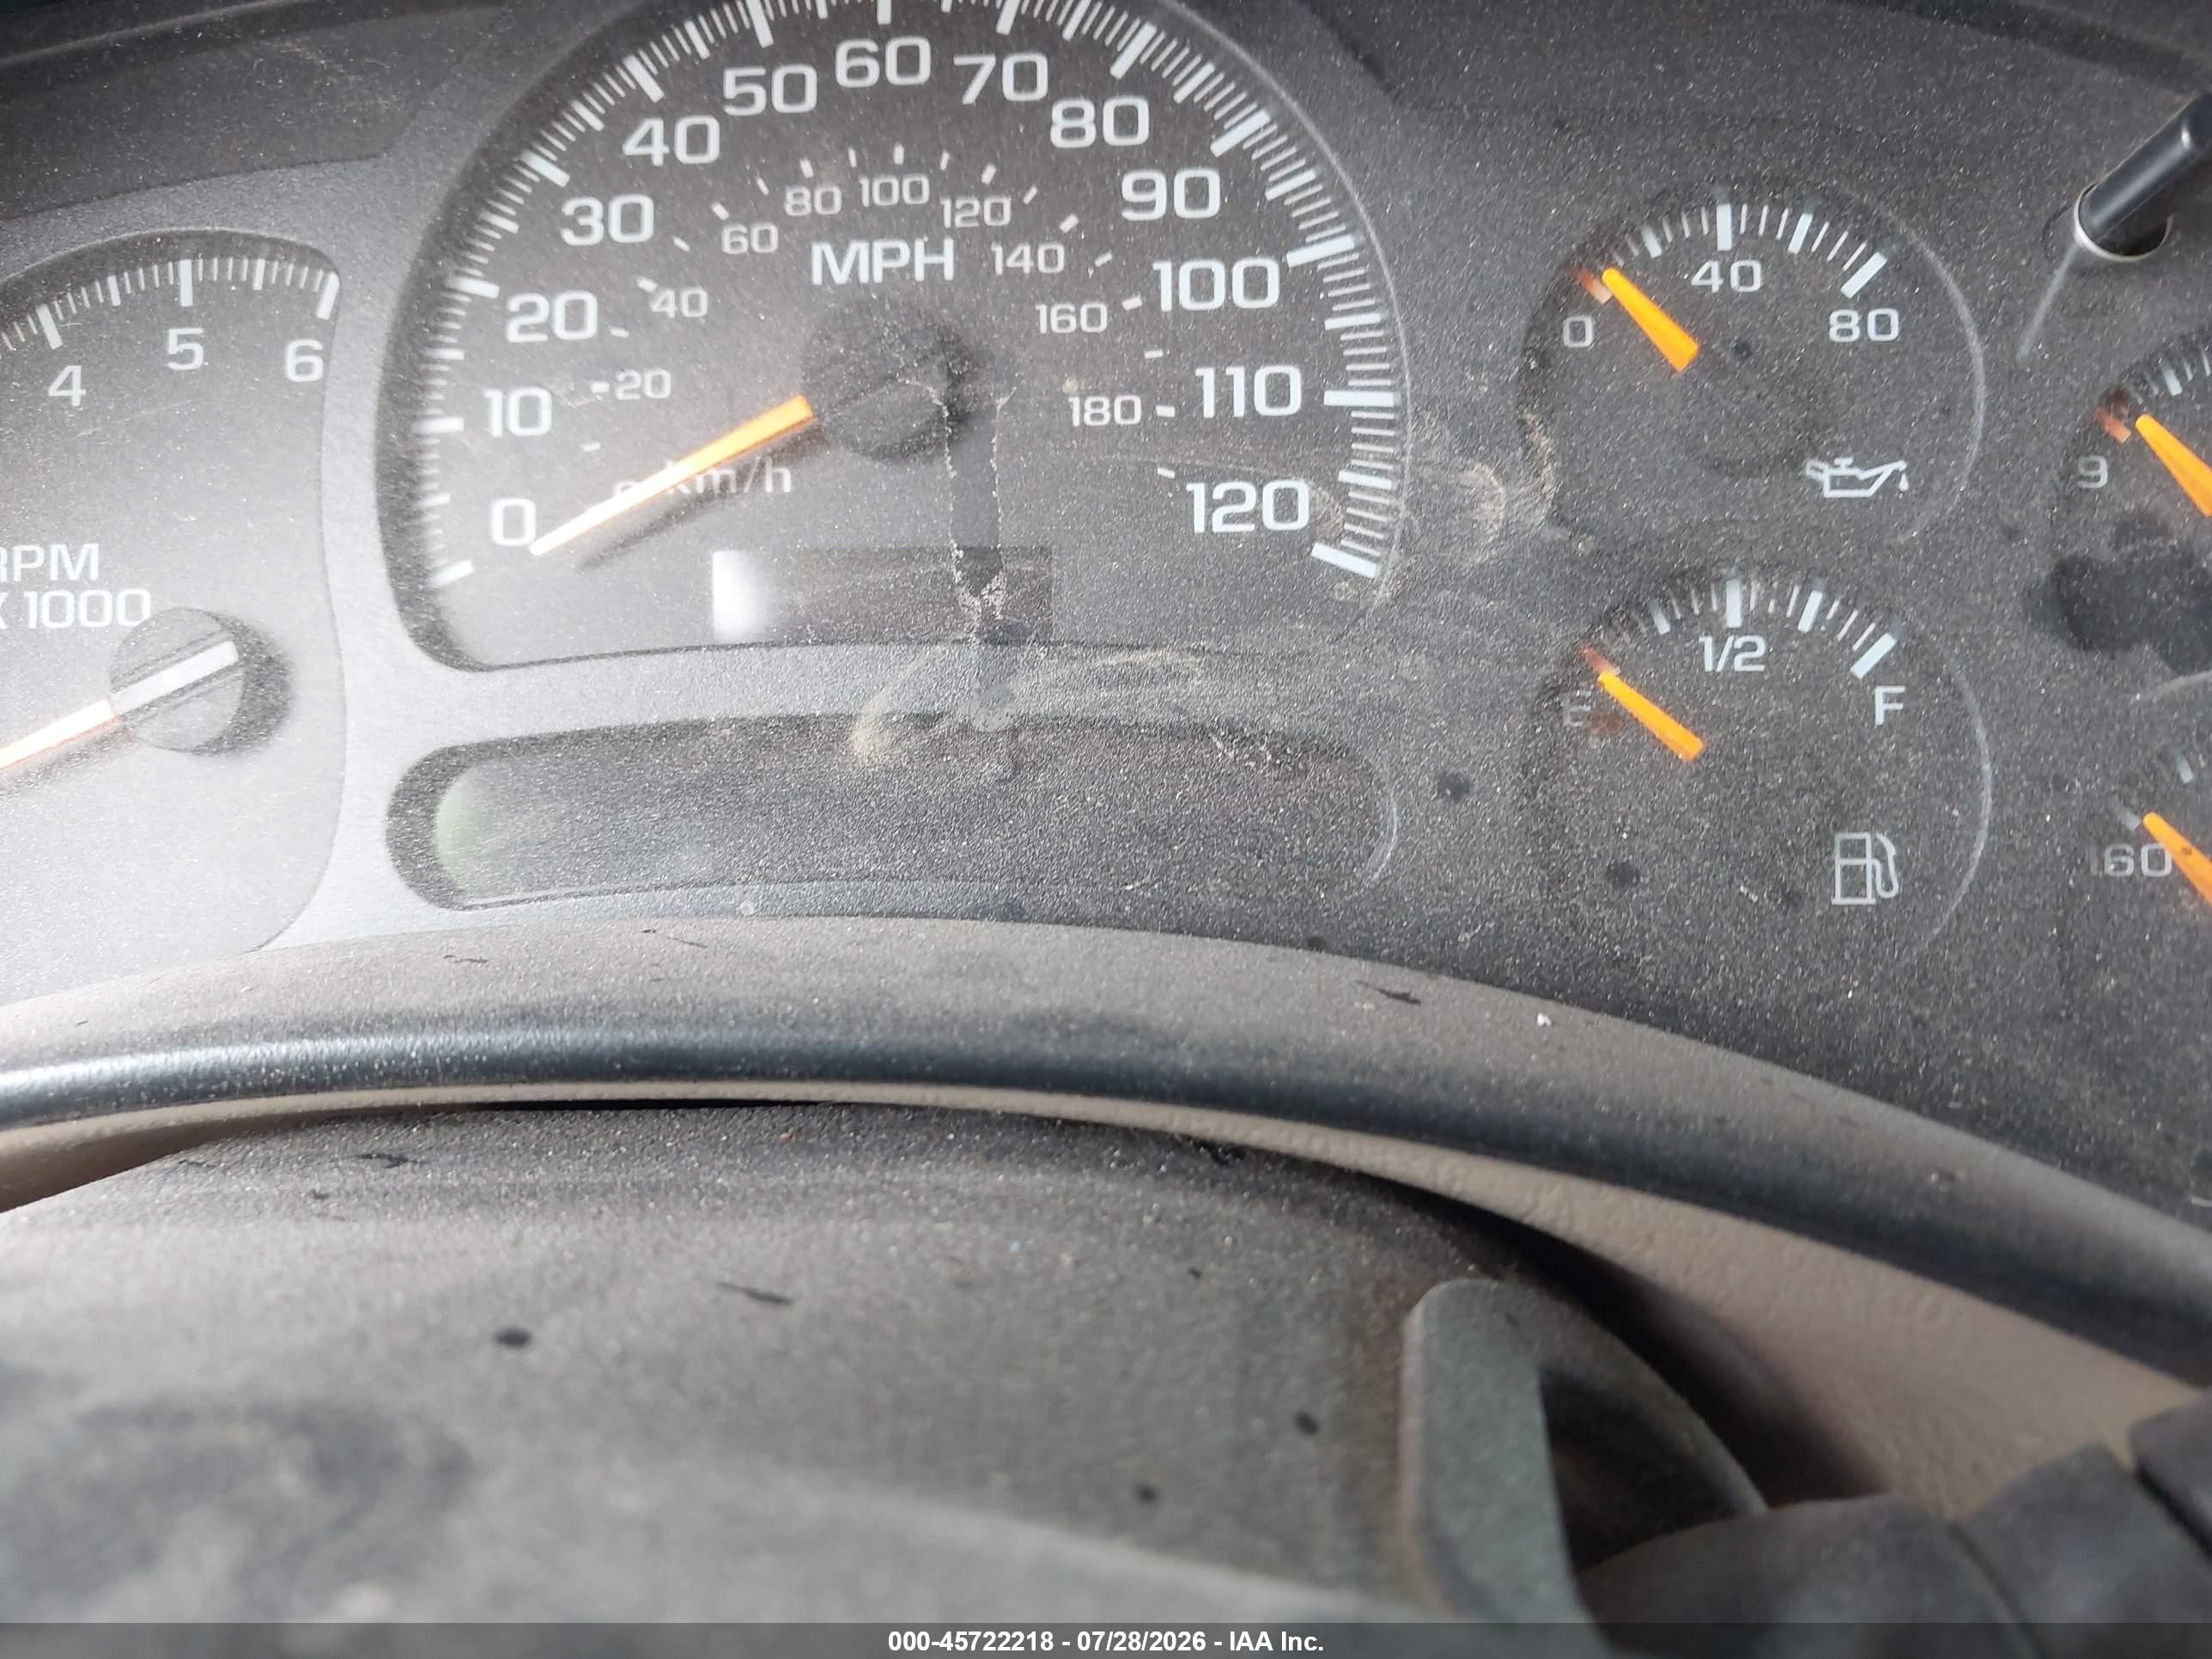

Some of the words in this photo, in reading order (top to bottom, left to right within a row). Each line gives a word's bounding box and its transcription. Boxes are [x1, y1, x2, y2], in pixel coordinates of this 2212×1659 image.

[836, 36, 931, 87] 60
[953, 52, 1048, 104] 70
[723, 64, 817, 116] 50
[622, 115, 720, 166] 40
[1050, 96, 1149, 148] 80
[784, 185, 842, 216] 80
[860, 175, 930, 207] 100
[1121, 168, 1220, 221] 90
[562, 194, 653, 246] 30
[940, 196, 1011, 228] 120
[722, 223, 778, 253] 60
[811, 238, 954, 284] MPH
[991, 243, 1065, 275] 140
[1692, 260, 1762, 293] 40
[651, 287, 708, 318] 40
[1152, 258, 1279, 312] 100
[506, 290, 598, 343] 20
[1036, 302, 1108, 333] 160
[1563, 314, 1595, 348] 0
[1828, 308, 1899, 343] 80
[167, 328, 204, 370] 5
[285, 339, 324, 381] 6
[49, 366, 85, 405] 4
[615, 369, 671, 399] 20
[1195, 366, 1301, 418] 110
[483, 386, 552, 437] 10
[1068, 395, 1141, 427] 180
[2077, 455, 2108, 489] 9
[489, 497, 537, 546] 0
[1187, 479, 1310, 534] 120
[0, 543, 100, 582] PM
[24, 588, 152, 629] 1000
[1698, 635, 1766, 672] 1/2
[1561, 690, 1592, 726] E
[1875, 686, 1905, 726] F
